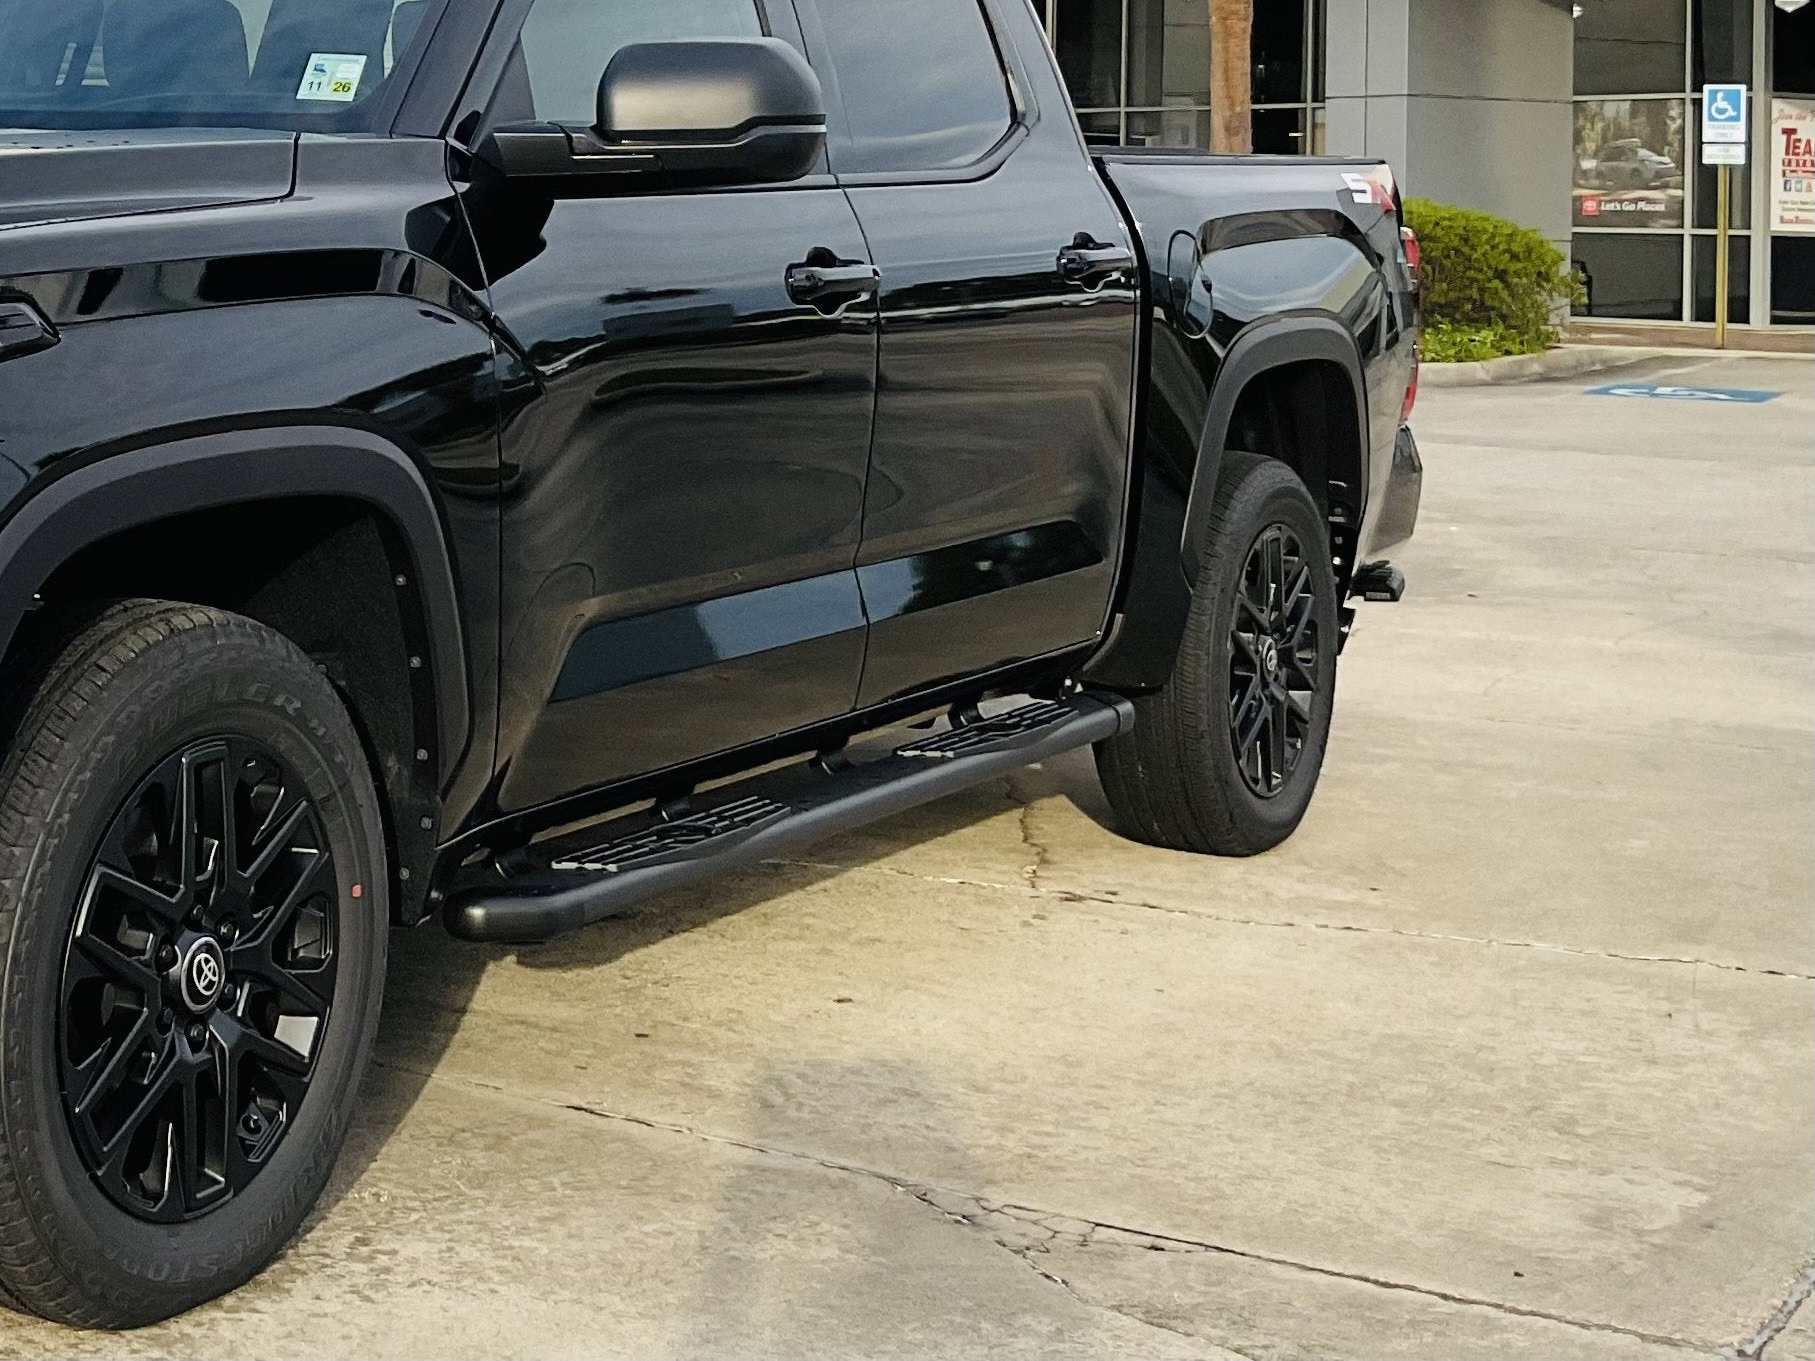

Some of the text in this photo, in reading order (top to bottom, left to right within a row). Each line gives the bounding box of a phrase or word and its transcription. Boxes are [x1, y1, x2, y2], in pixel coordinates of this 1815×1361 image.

[308, 81, 351, 92] 11 26
[1781, 127, 1815, 156] TEA
